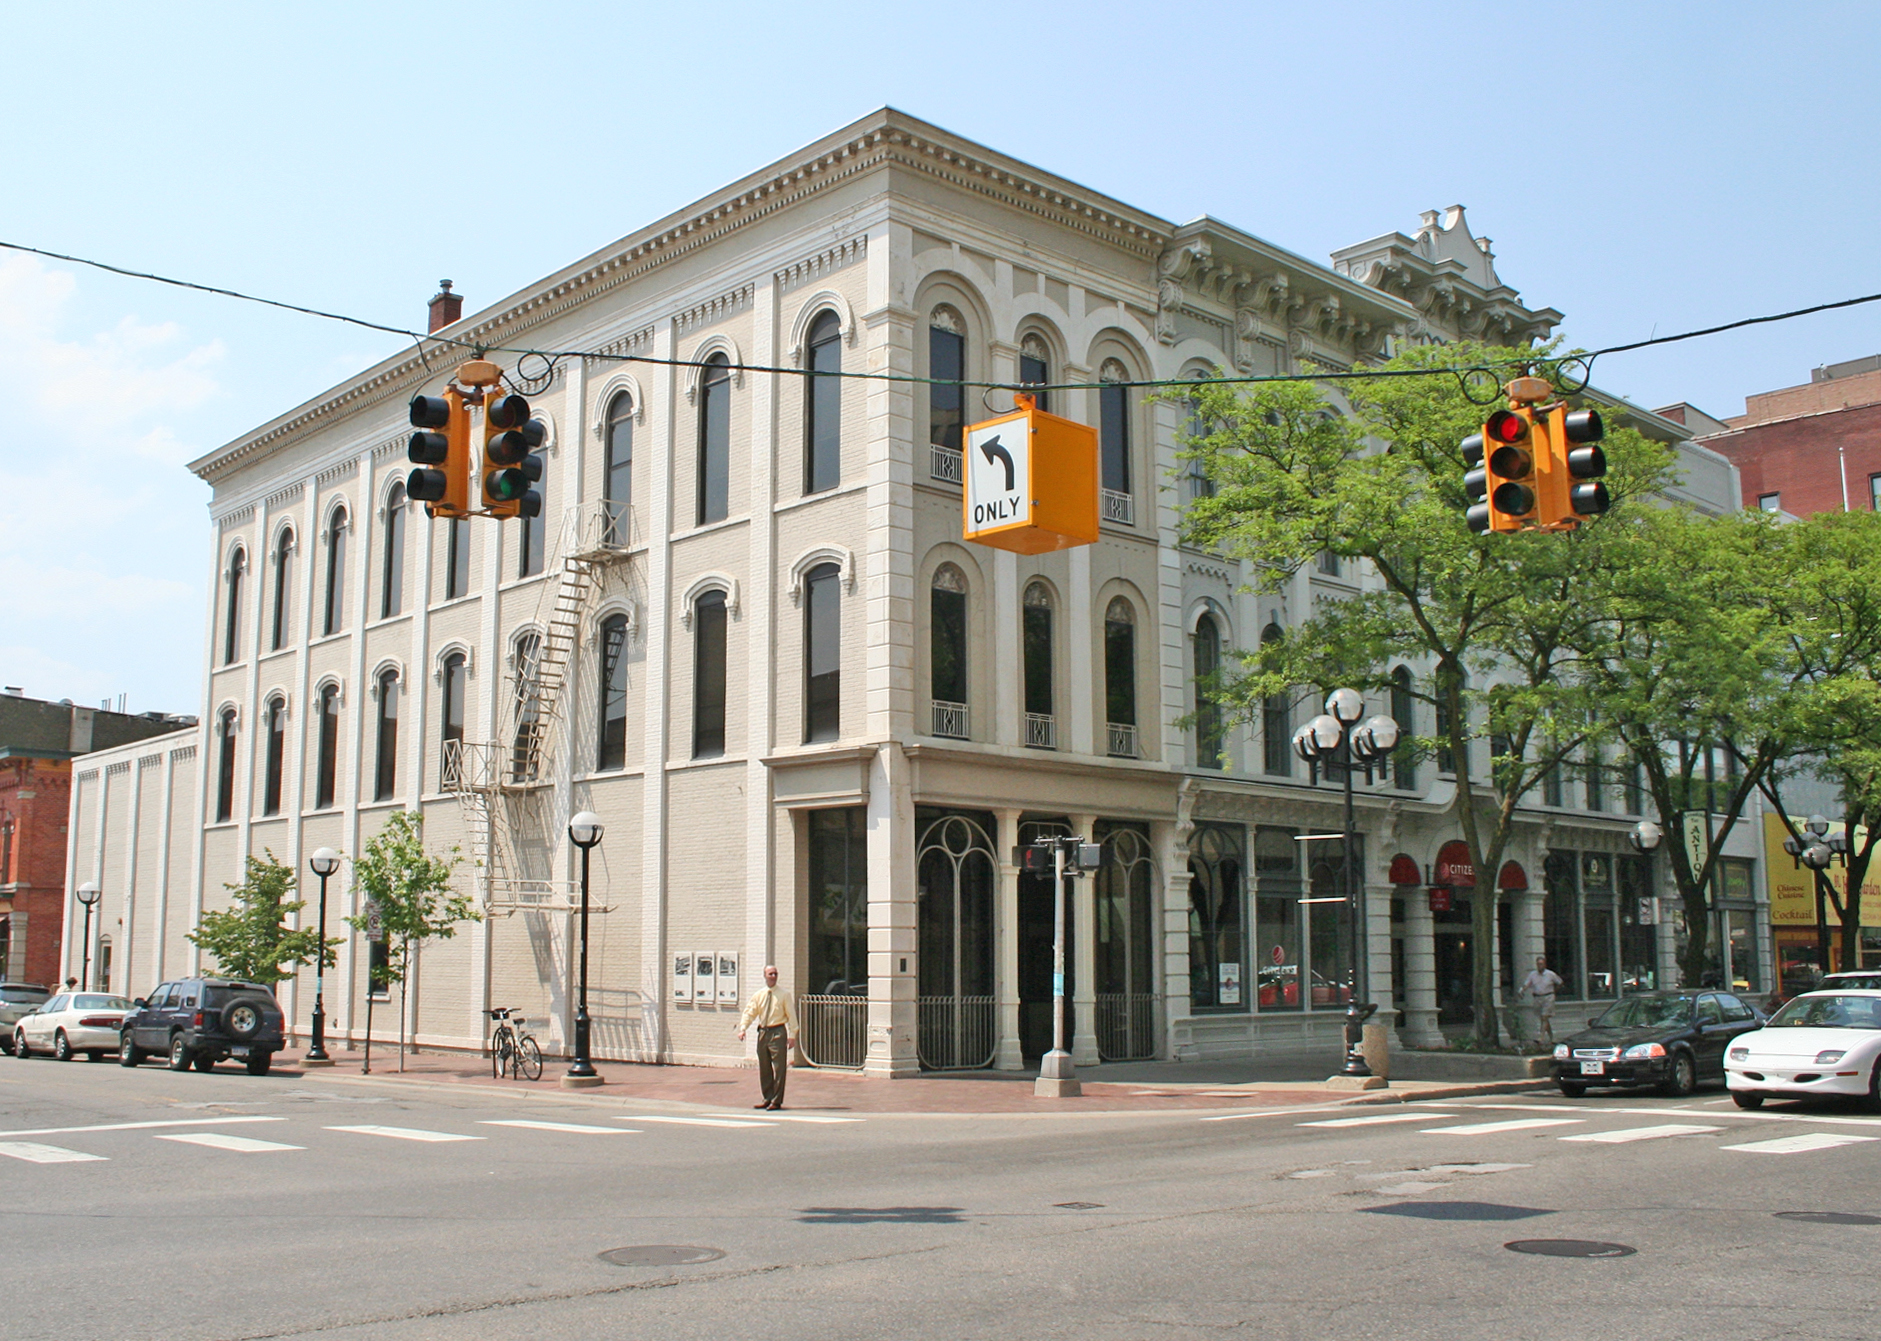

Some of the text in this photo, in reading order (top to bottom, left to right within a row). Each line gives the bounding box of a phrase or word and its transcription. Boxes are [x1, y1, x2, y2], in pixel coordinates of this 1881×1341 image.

[974, 496, 1020, 524] ONLY
[1449, 864, 1475, 876] CITIZE
[1776, 884, 1804, 892] Chinese
[1772, 908, 1812, 920] Cocktail
